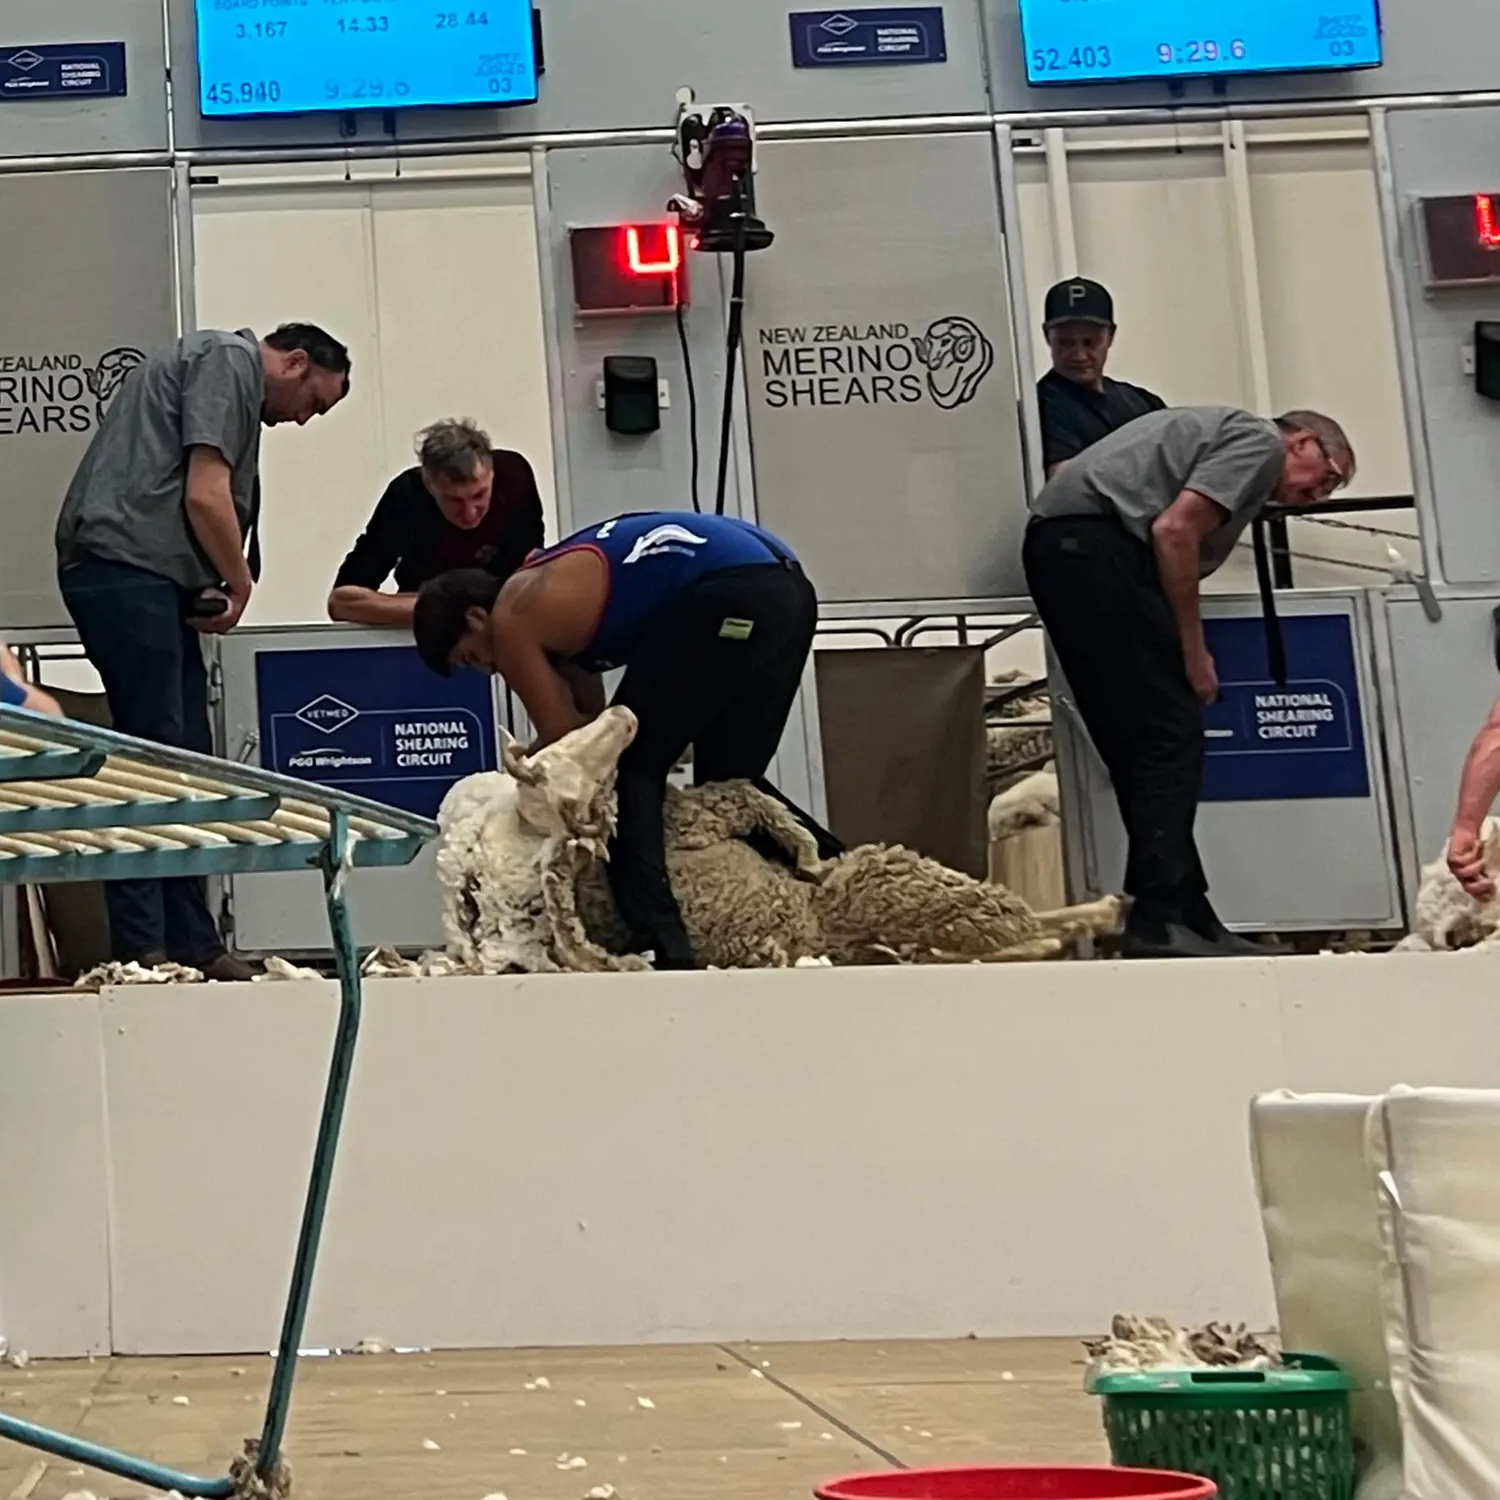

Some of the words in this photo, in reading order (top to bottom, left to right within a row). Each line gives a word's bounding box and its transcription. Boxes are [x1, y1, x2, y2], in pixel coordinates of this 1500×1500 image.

[236, 21, 287, 38] 3.167
[1032, 46, 1112, 71] 52.403
[1156, 38, 1246, 64] 9:29.6
[1068, 285, 1086, 307] P
[759, 328, 806, 344] NEW
[813, 323, 909, 342] ZEALAND
[763, 344, 912, 376] MERINO
[765, 375, 922, 407] SHEARS
[1255, 694, 1332, 707] NATIONAL
[1256, 708, 1334, 724] SHEARING
[394, 721, 468, 736] NATIONAL
[1258, 724, 1318, 739] CIRCUIT
[395, 736, 469, 752] SHEARING
[397, 752, 453, 767] CIRCUIT
